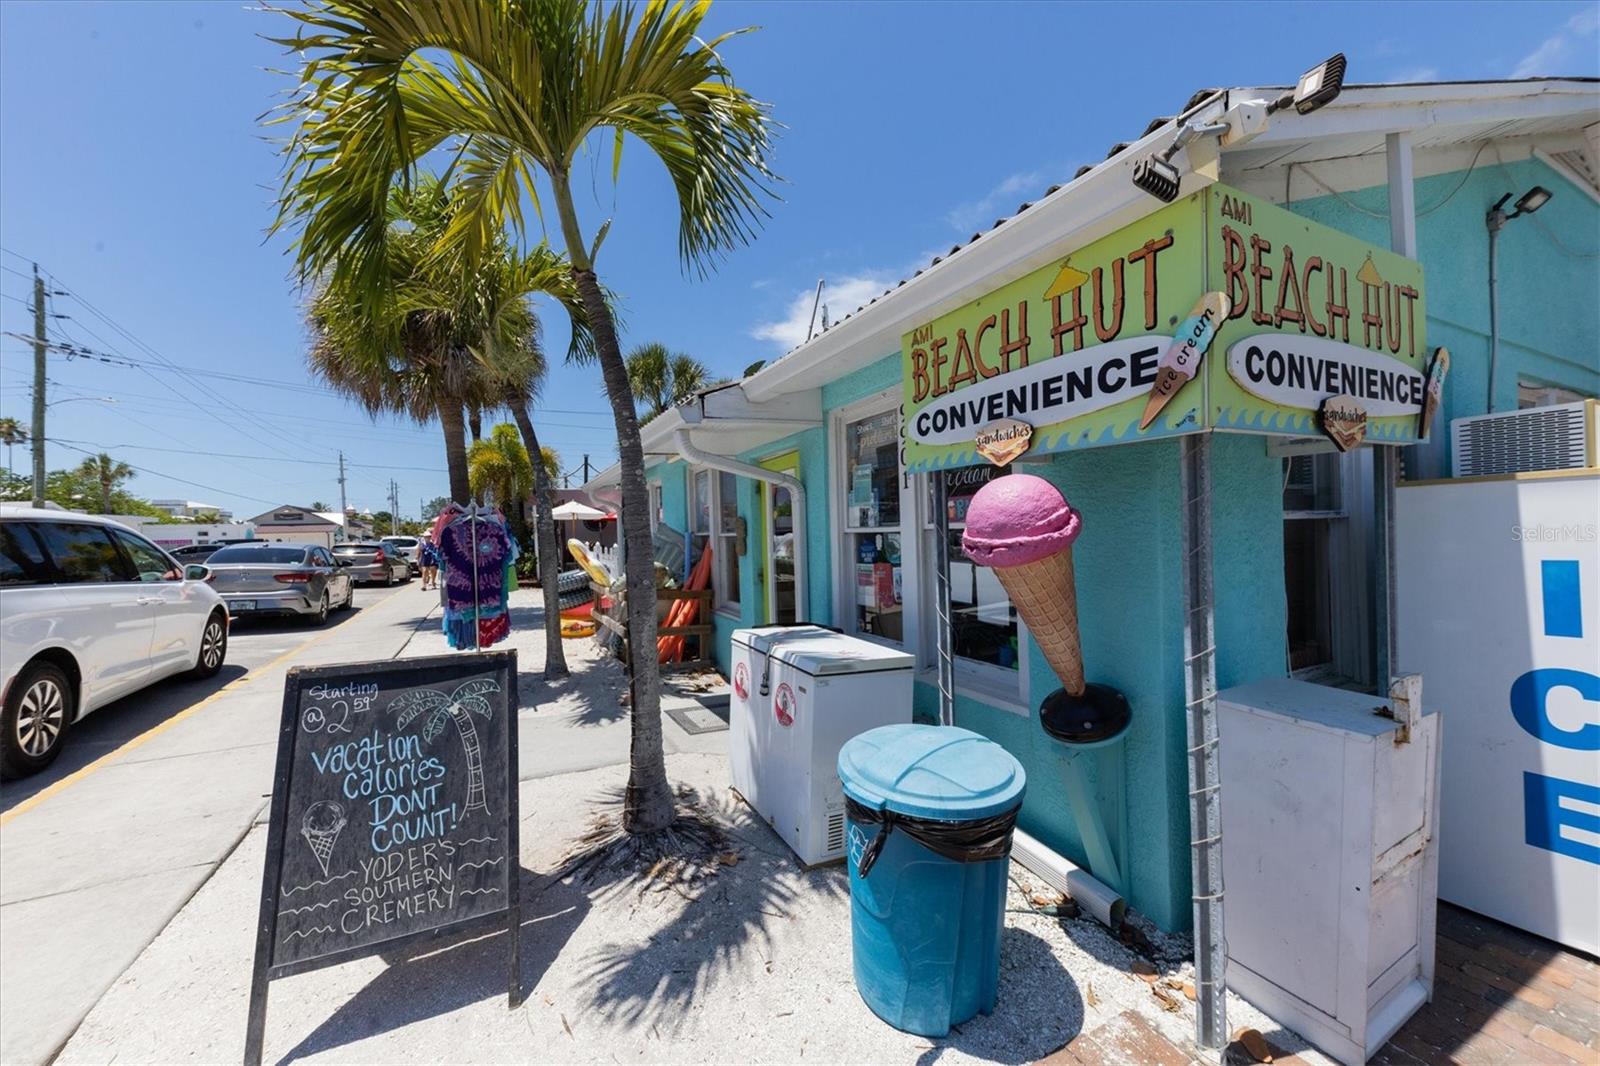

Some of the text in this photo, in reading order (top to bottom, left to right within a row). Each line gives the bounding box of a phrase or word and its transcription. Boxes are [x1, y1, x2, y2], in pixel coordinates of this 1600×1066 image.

[1221, 195, 1252, 226] AMI
[1221, 224, 1418, 358] BEACH HUT
[911, 325, 934, 347] AMI
[912, 235, 1174, 403] BEACH HUT
[1155, 308, 1215, 396] ice cream
[1245, 345, 1424, 405] CONVENIENCE
[916, 347, 1159, 438] CONVENIENCE
[976, 424, 1030, 445] sandwiches
[308, 681, 379, 701] Starting
[368, 783, 443, 826] DONT
[371, 802, 457, 853] COUNT!
[344, 863, 452, 907] SOUTHERN
[359, 838, 457, 884] YODER'S
[341, 885, 456, 935] CREMERY
